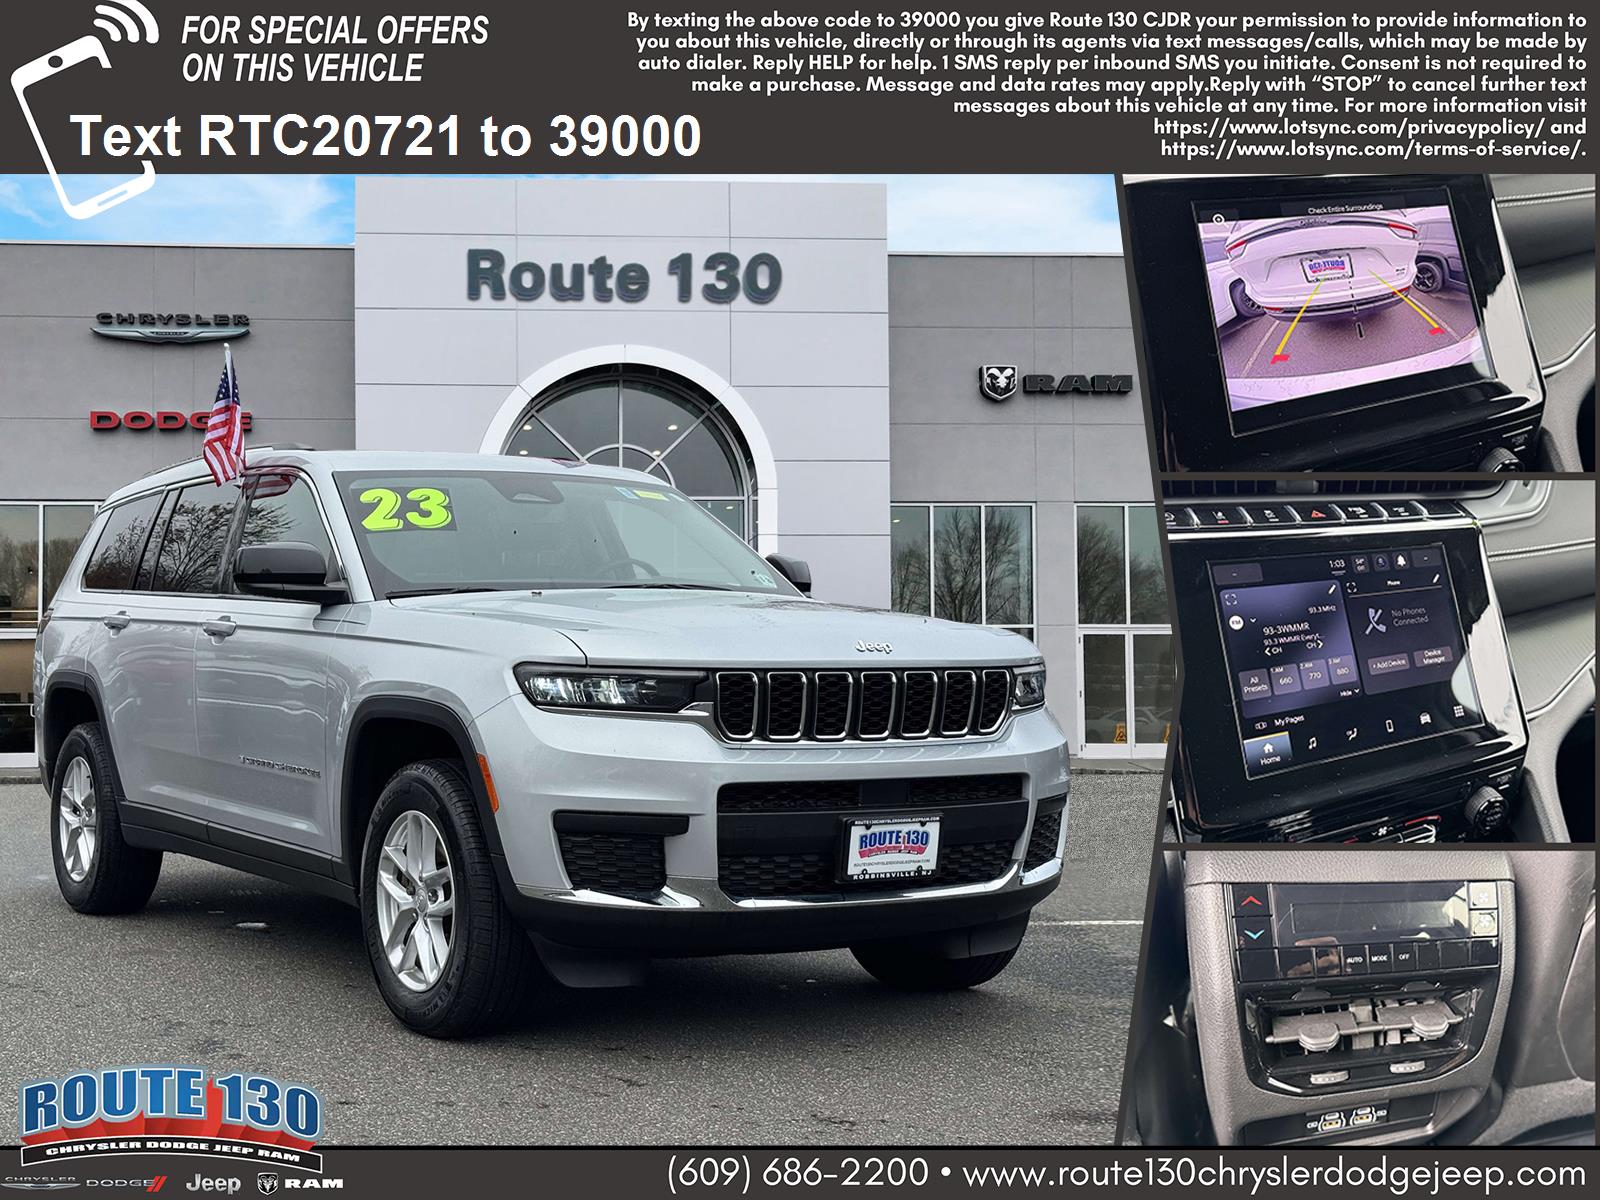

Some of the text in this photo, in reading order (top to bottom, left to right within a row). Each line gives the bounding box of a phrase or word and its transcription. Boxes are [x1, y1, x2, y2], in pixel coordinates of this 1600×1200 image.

[1308, 203, 1384, 214] Check Entire Surroundings
[466, 249, 783, 304] Route 130
[96, 312, 250, 326] CHRYSLER
[1023, 374, 1133, 394] RAM
[360, 488, 452, 531] 23
[1329, 560, 1345, 568] 1:03
[1402, 607, 1426, 616] Phones
[1393, 615, 1429, 627] Connected
[855, 640, 892, 655] Jeep
[1424, 649, 1442, 657] Device
[1309, 672, 1321, 680] 770
[1243, 685, 1269, 694] Presets
[1274, 714, 1305, 728] My Pages
[1260, 755, 1281, 766] Home
[859, 830, 929, 849] ROUTE 130
[1371, 954, 1387, 962] MODE
